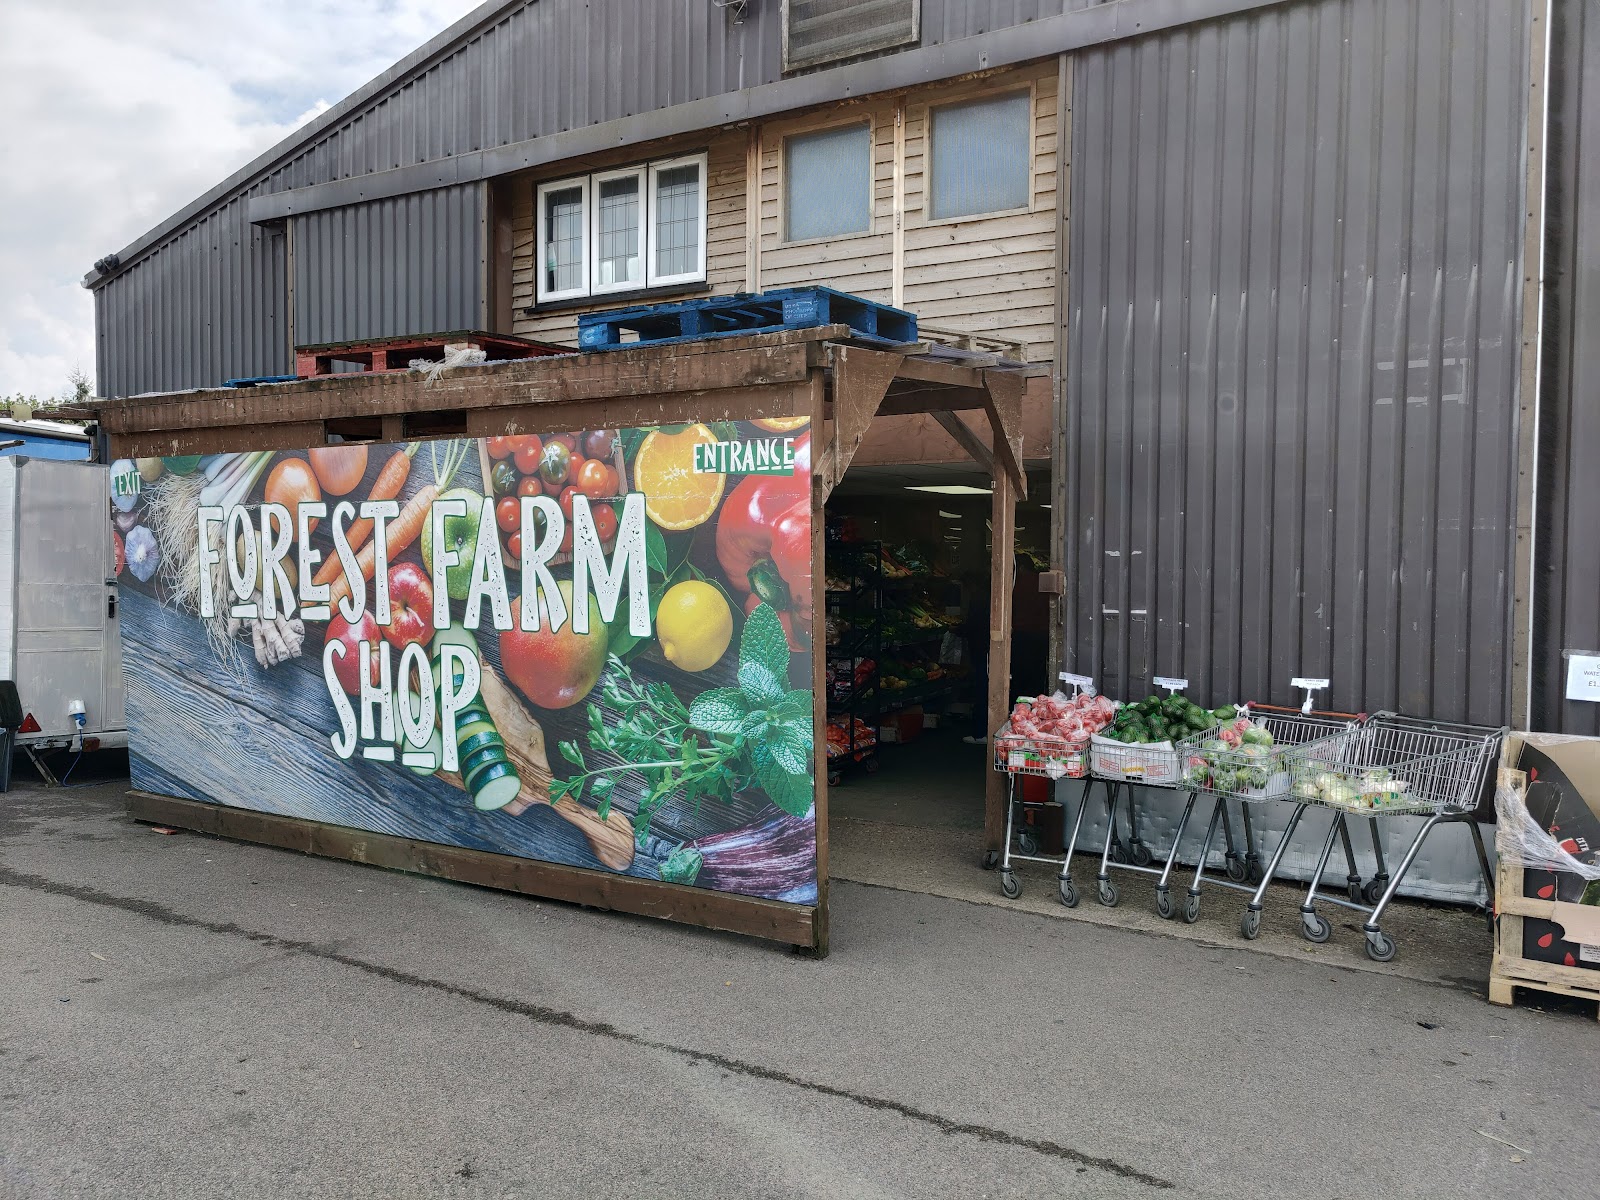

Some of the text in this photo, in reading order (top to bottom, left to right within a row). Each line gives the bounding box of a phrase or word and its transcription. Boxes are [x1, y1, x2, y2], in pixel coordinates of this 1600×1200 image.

[118, 471, 141, 495] EXIT
[693, 438, 795, 473] ENTRANCE
[197, 492, 652, 637] FOREST FARM
[322, 638, 482, 772] SHOP
